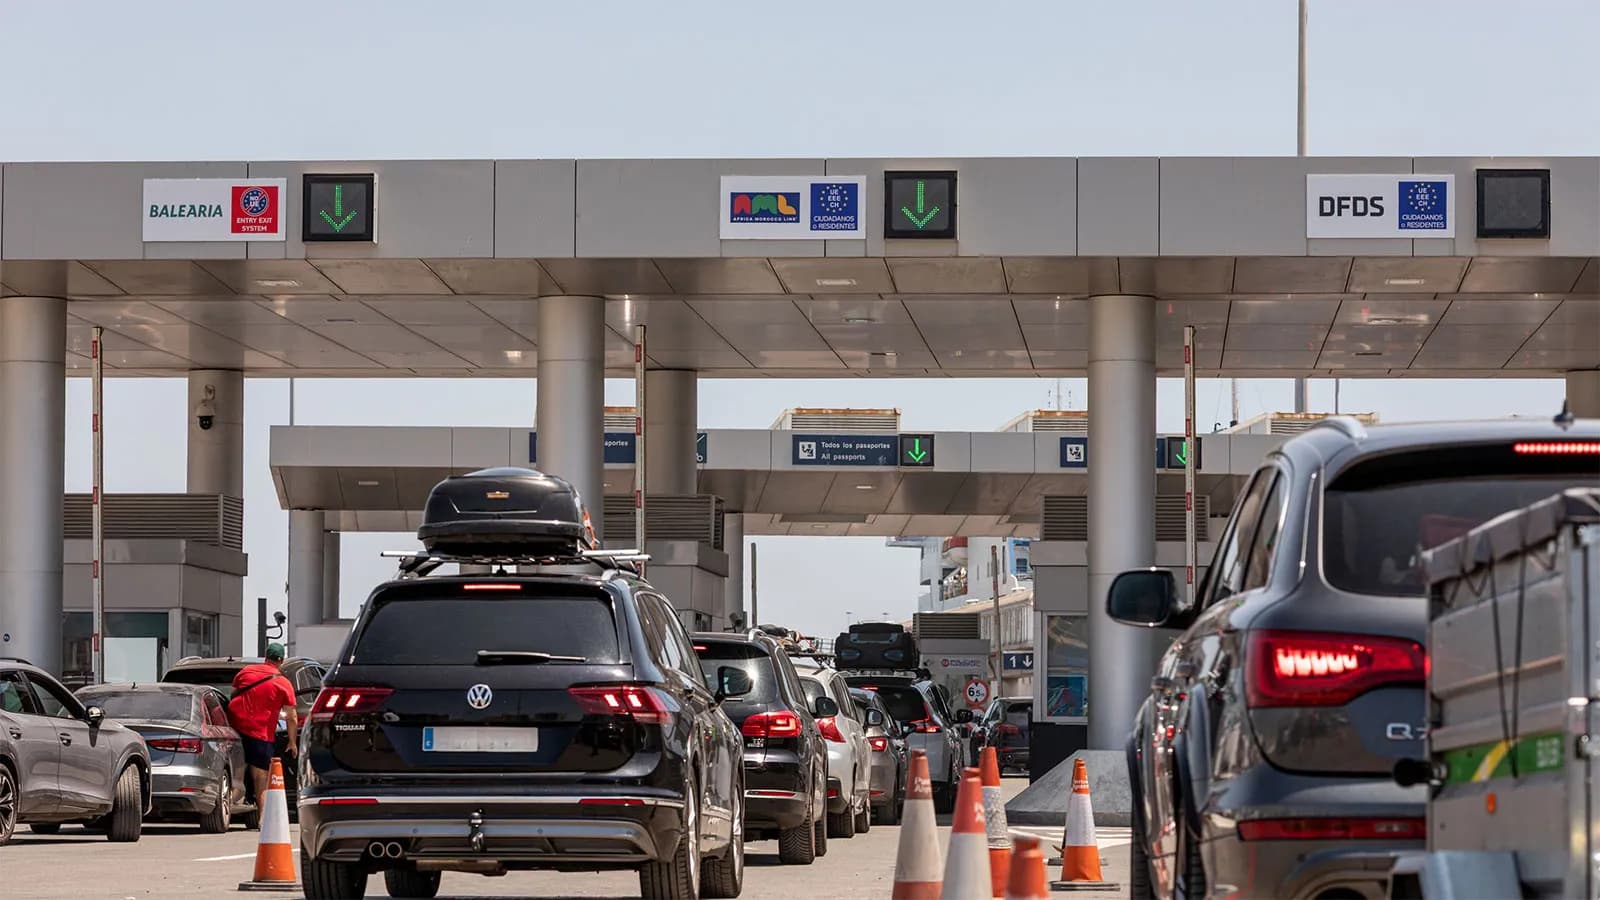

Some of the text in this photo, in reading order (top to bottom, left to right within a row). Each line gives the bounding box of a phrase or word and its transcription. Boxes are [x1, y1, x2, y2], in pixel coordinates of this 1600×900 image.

[734, 194, 796, 215] AML
[1319, 196, 1384, 216] DFDS
[856, 442, 890, 450] pasaportes
[1009, 656, 1016, 668] 1
